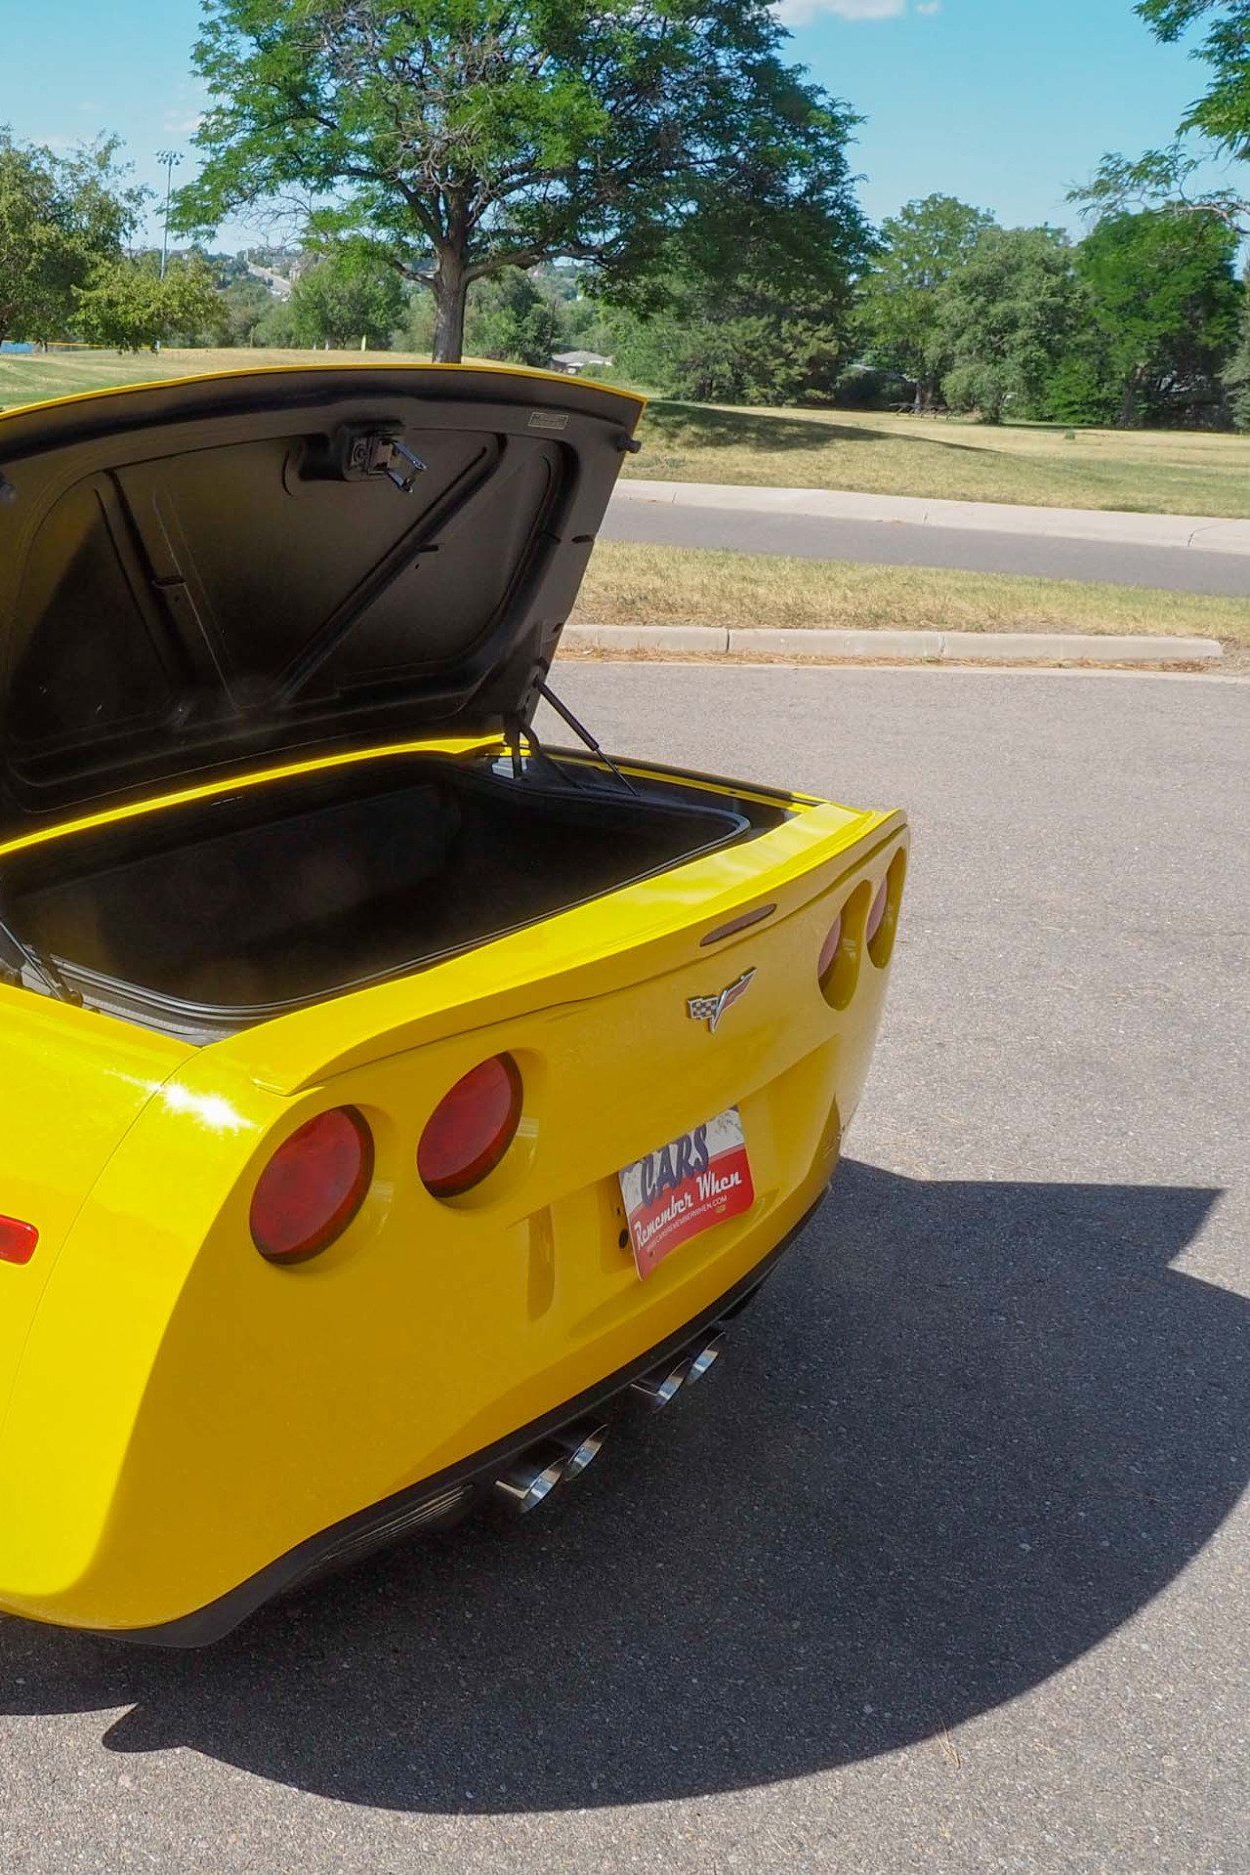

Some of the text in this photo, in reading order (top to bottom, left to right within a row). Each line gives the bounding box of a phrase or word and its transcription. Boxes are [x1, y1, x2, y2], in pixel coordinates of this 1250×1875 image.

[640, 1122, 710, 1208] CARS
[634, 1191, 694, 1251] Remember
[696, 1169, 743, 1201] When
